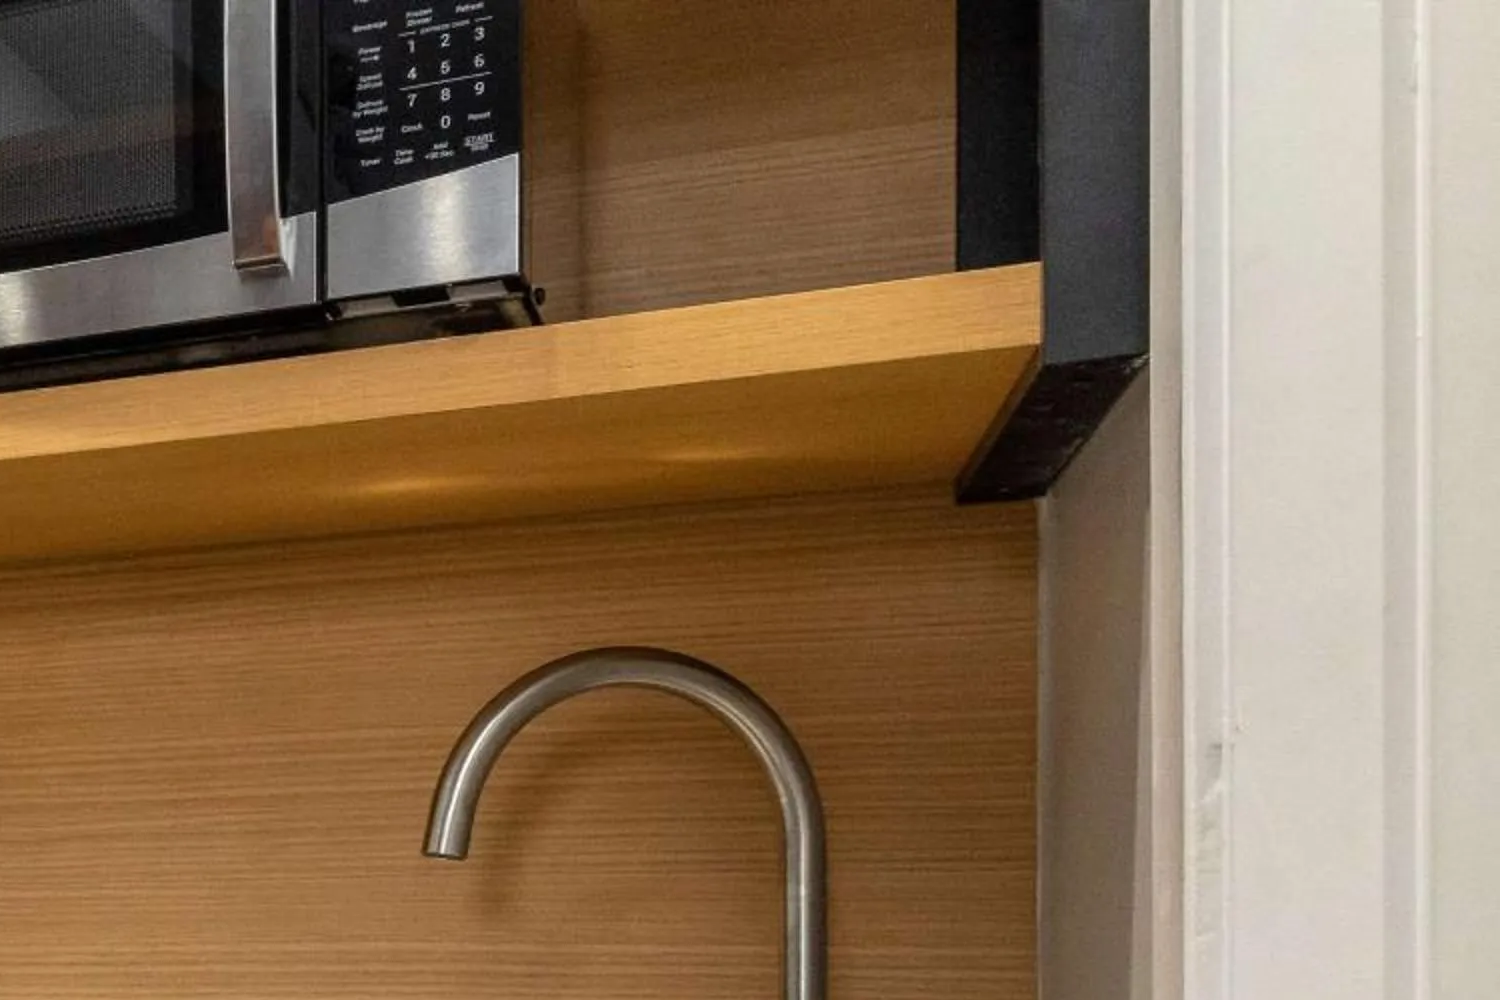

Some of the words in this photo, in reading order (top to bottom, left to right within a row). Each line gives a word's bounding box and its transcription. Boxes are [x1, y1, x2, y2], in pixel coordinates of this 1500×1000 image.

[407, 39, 415, 53] 1
[440, 33, 451, 47] 2
[474, 27, 485, 41] 3
[407, 66, 417, 80] 4
[440, 60, 451, 75] 5
[474, 53, 485, 68] 6
[407, 93, 417, 107] 7
[440, 87, 451, 101] 8
[474, 81, 485, 95] 9
[441, 115, 451, 129] 0
